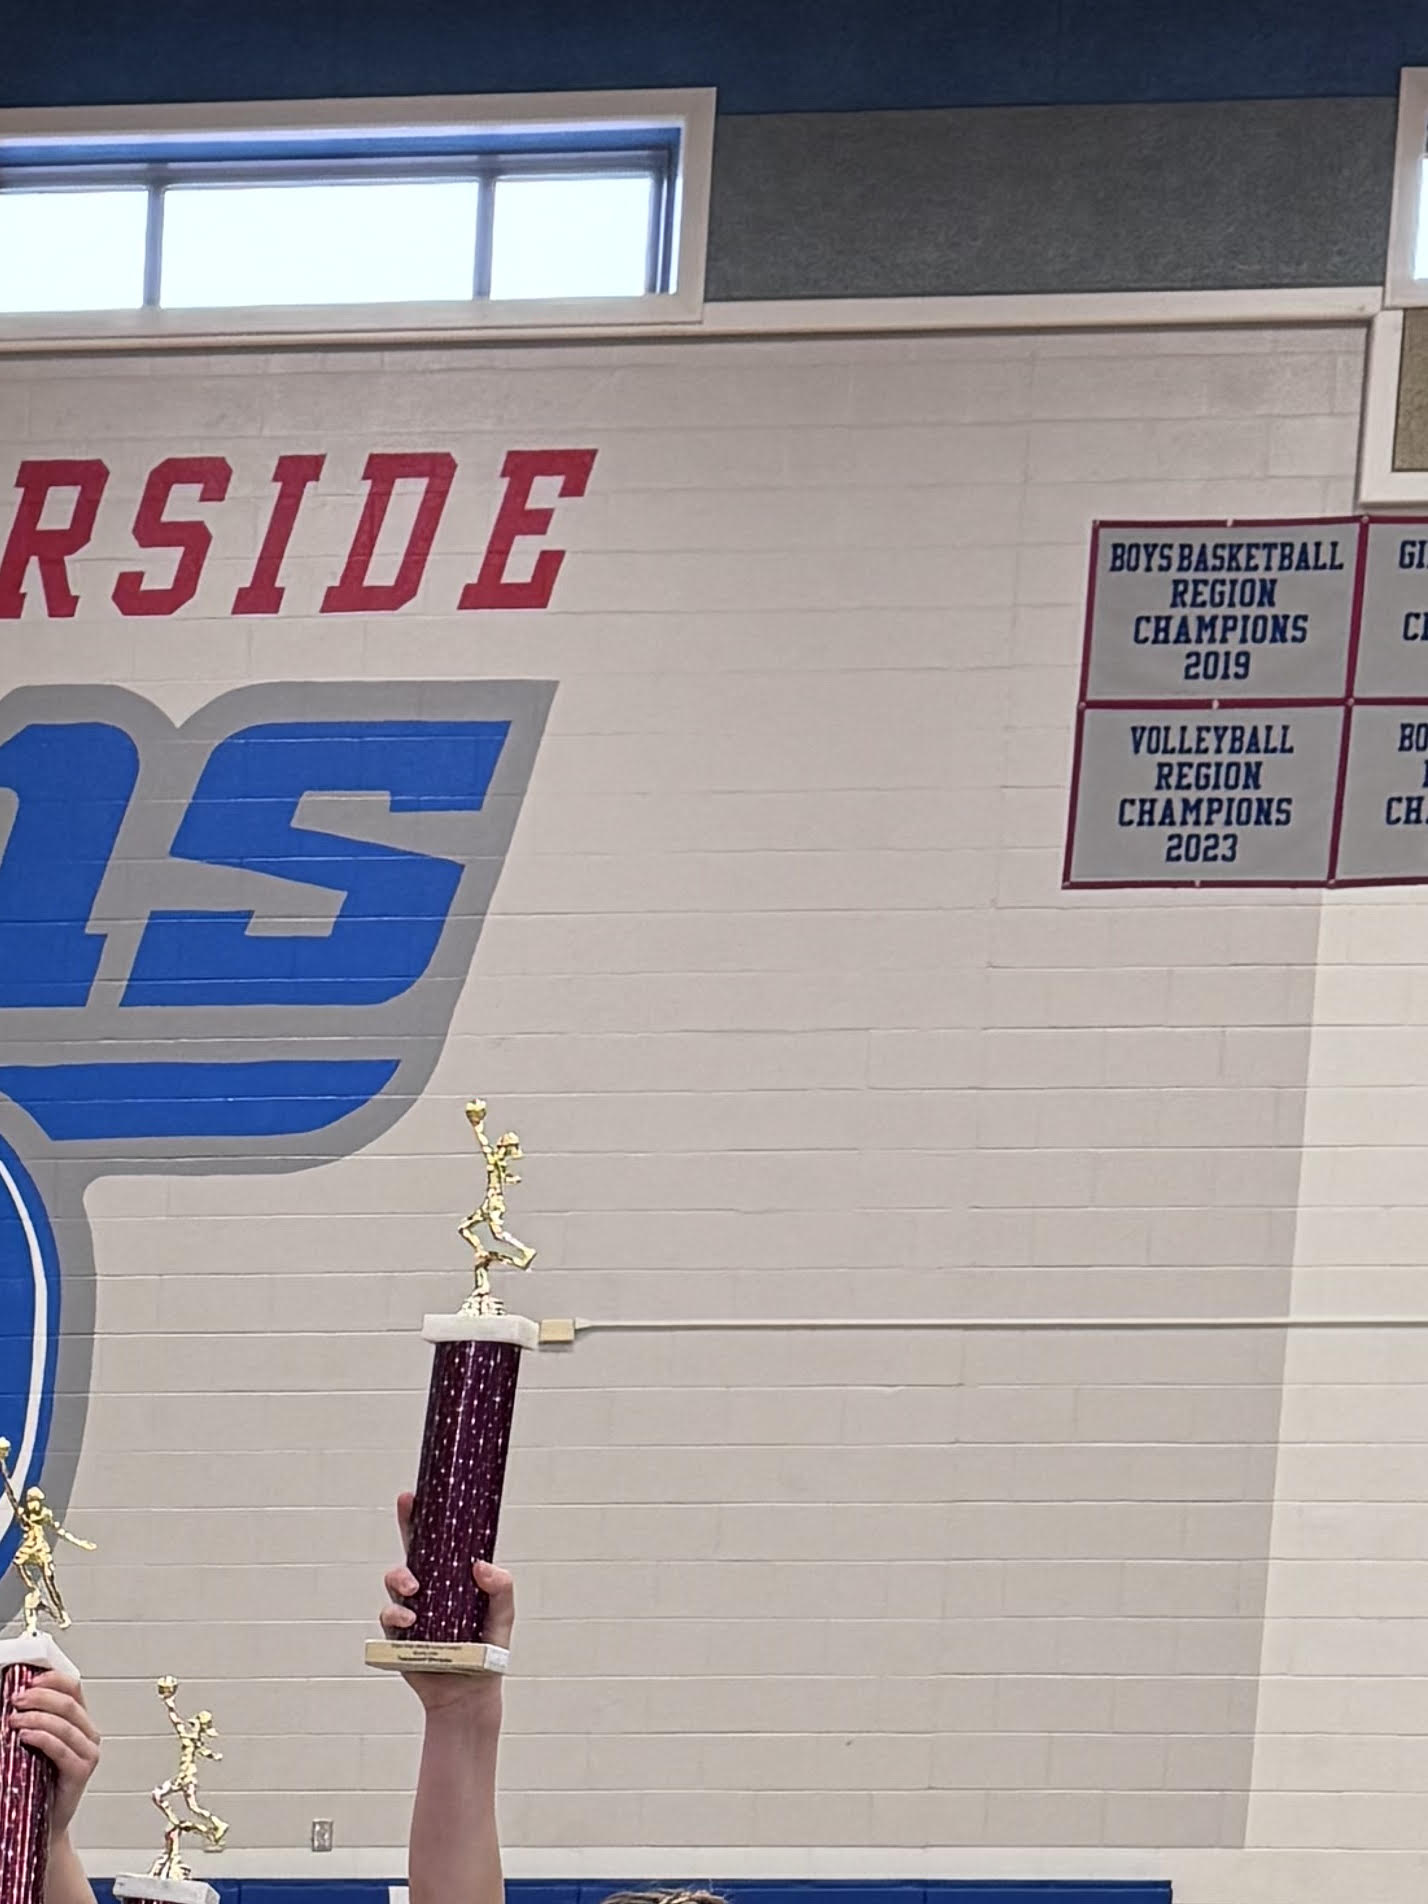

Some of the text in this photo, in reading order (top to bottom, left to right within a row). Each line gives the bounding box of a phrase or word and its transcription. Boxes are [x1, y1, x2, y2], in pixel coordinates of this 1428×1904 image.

[1110, 541, 1344, 572] BOYS BASKETBALL
[1170, 579, 1277, 608] REGION
[1134, 614, 1308, 644] CHAMPIONS
[1185, 651, 1250, 680] 2019
[1131, 725, 1293, 754] VOLLEYBALL
[1155, 761, 1262, 790] REGION
[1119, 798, 1292, 826] CHAMPIONS
[1166, 834, 1237, 862] 2023
